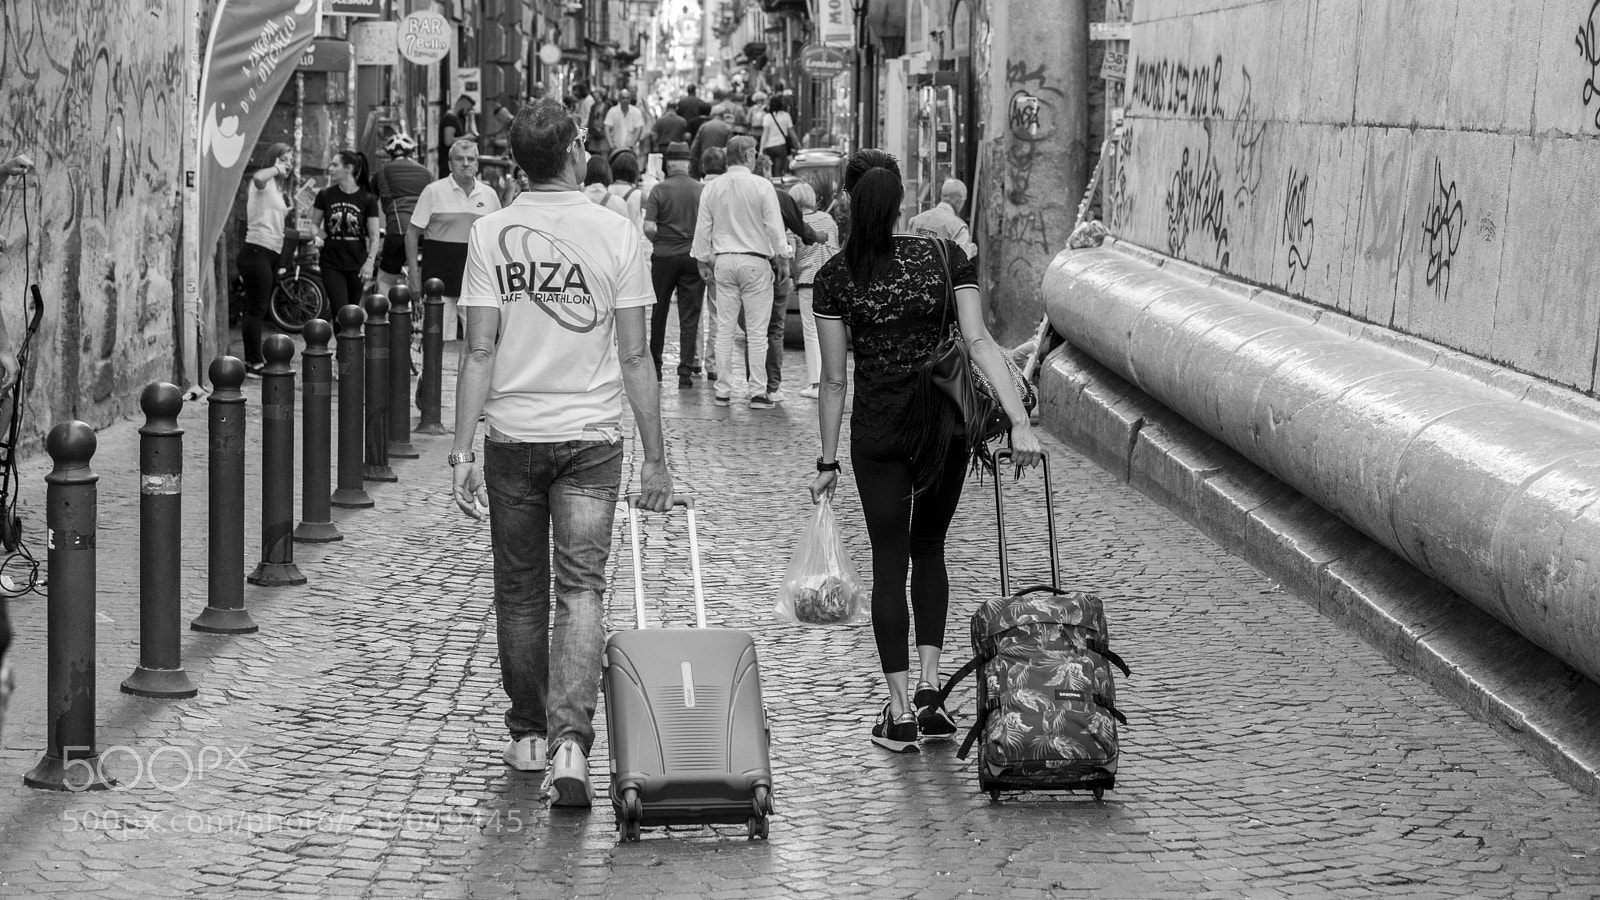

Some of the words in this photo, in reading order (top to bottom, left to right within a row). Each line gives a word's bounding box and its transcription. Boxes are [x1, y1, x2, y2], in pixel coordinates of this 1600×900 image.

[409, 17, 443, 35] BAR
[495, 261, 591, 295] IBIZA
[528, 291, 591, 305] TRIATHLON
